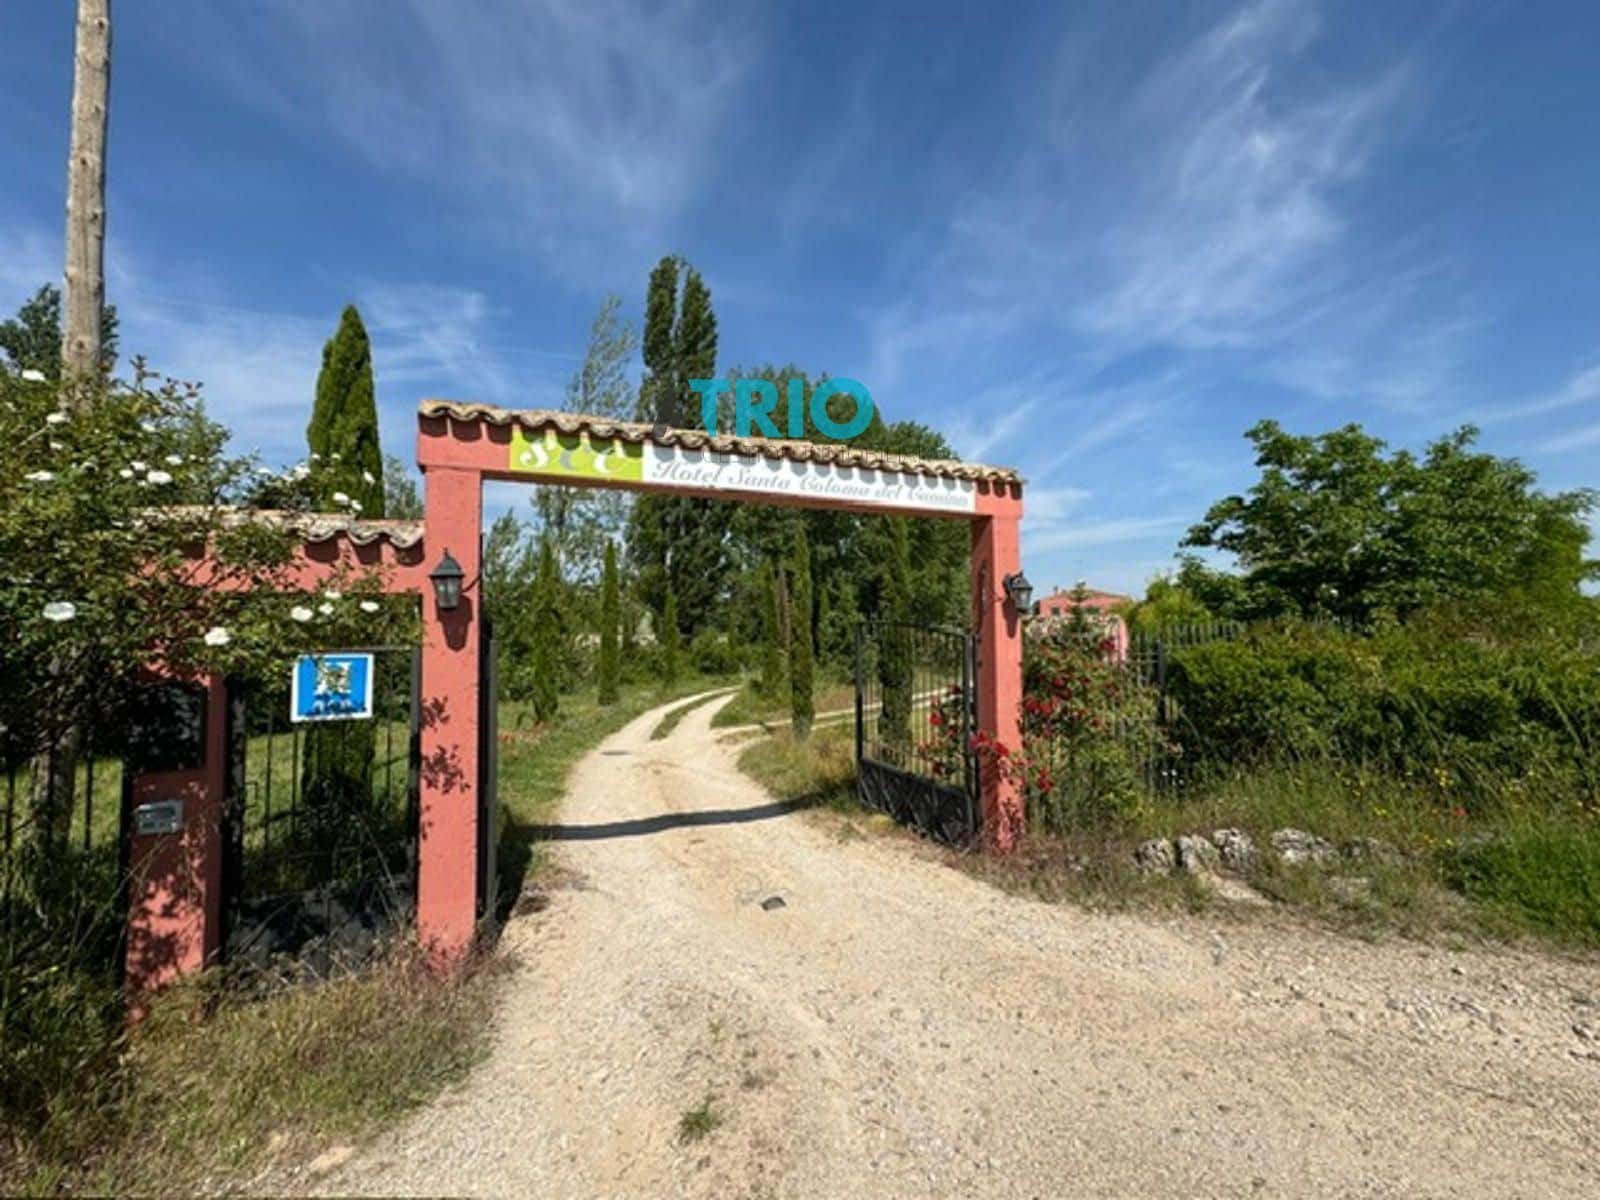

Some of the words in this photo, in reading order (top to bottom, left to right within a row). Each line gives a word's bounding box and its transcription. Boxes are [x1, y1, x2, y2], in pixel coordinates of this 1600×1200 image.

[652, 462, 722, 482] Hotel
[728, 466, 792, 489] Santa
[874, 483, 904, 500] del
